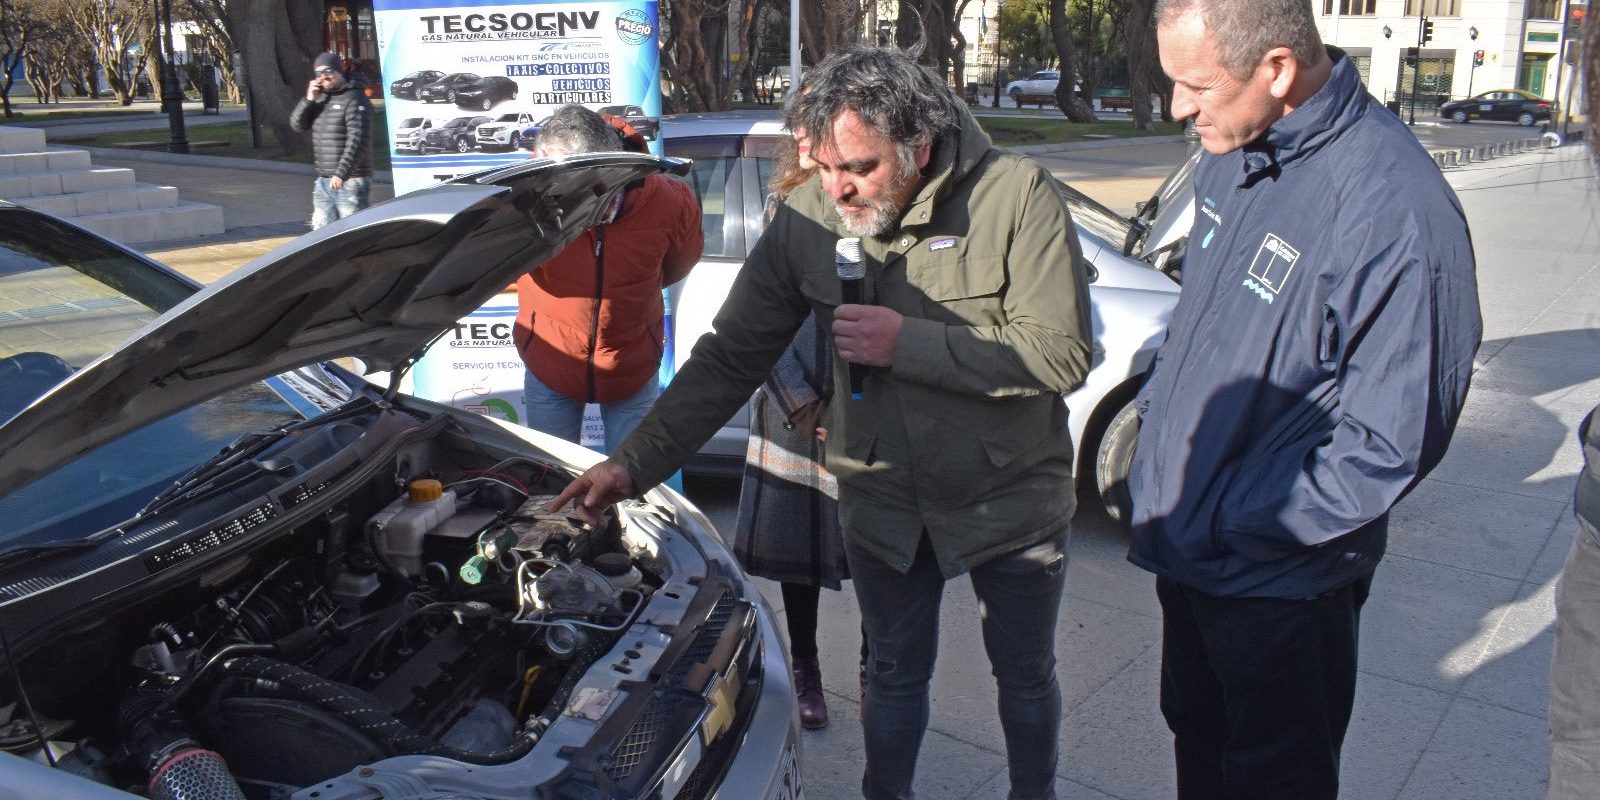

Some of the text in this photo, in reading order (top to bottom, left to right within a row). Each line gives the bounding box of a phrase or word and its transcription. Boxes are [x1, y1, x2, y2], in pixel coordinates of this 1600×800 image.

[461, 55, 515, 63] INSTALACION
[531, 53, 550, 61] GNC
[563, 52, 610, 60] VEHICULOS
[507, 63, 610, 75] TAXIS-COLECTIVOS
[534, 93, 611, 104] PARTICULARES
[452, 362, 494, 370] SERVICIO
